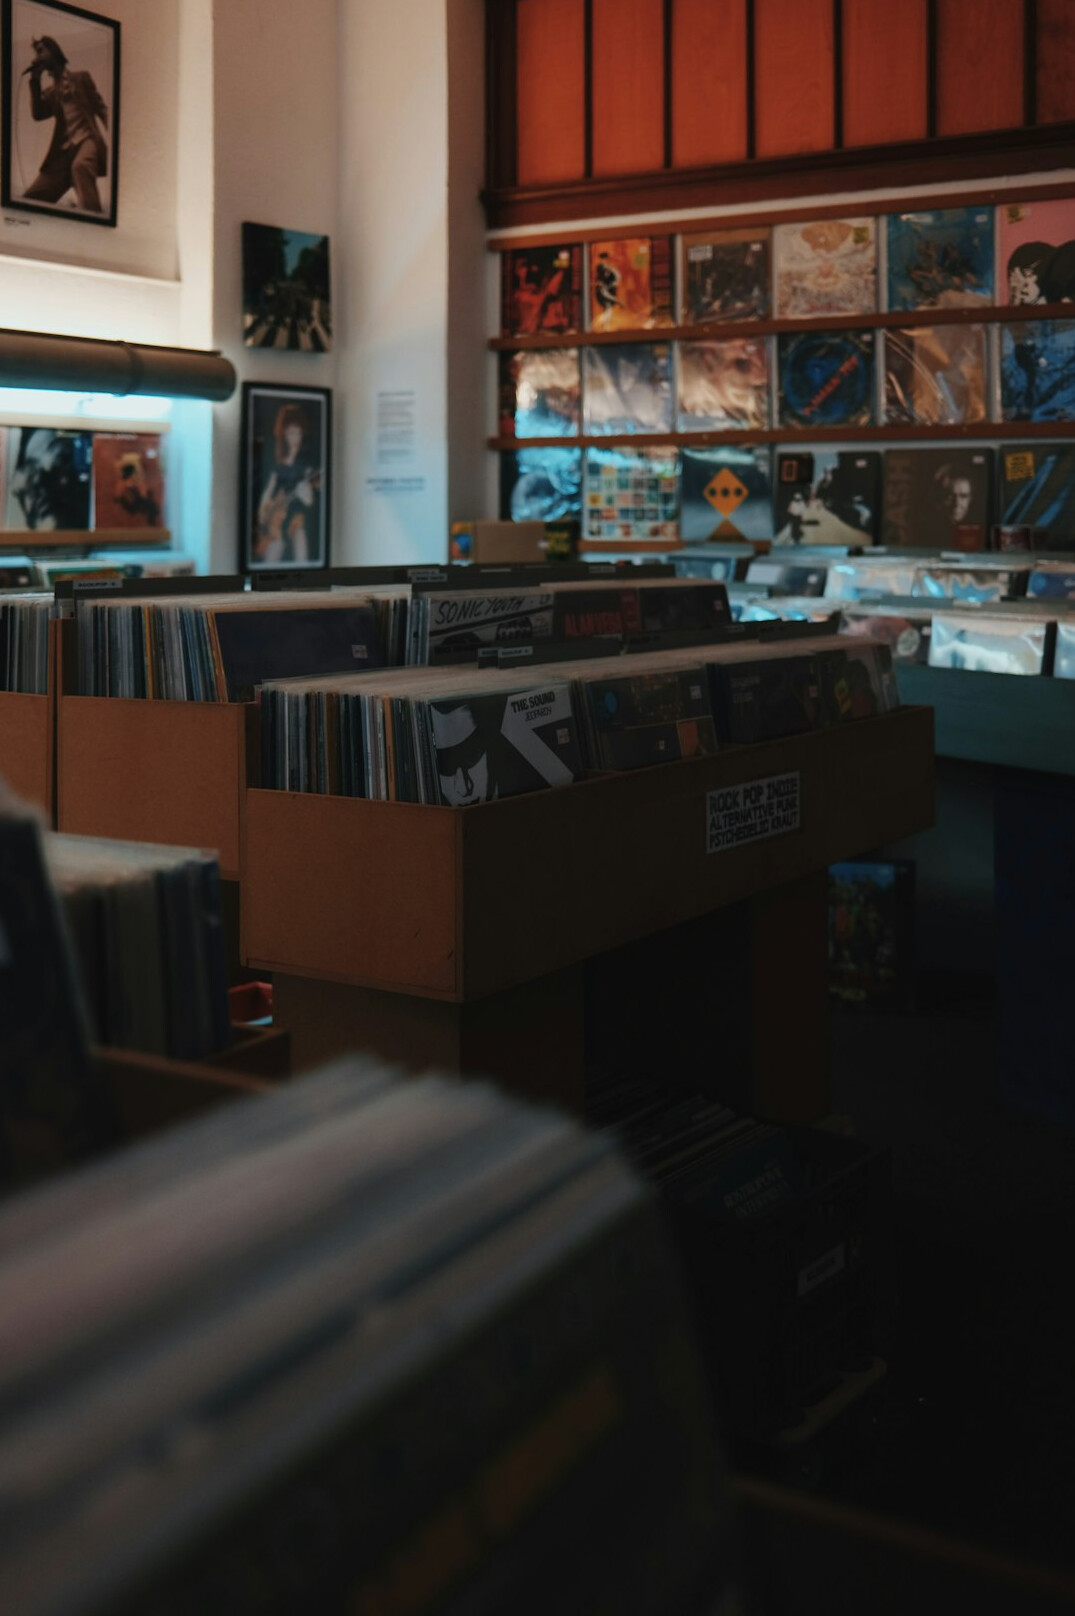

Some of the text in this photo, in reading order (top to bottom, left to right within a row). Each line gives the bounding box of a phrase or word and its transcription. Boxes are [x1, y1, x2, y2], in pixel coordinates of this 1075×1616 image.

[434, 598, 485, 626] SONIC
[485, 597, 525, 615] YOUTH
[511, 691, 555, 713] THE SOUND
[710, 778, 797, 814] ROCK POP INDIE
[710, 796, 797, 831] ALTERNATIVE PUNK
[709, 811, 798, 849] PSYCHEDELIC KRAUT
